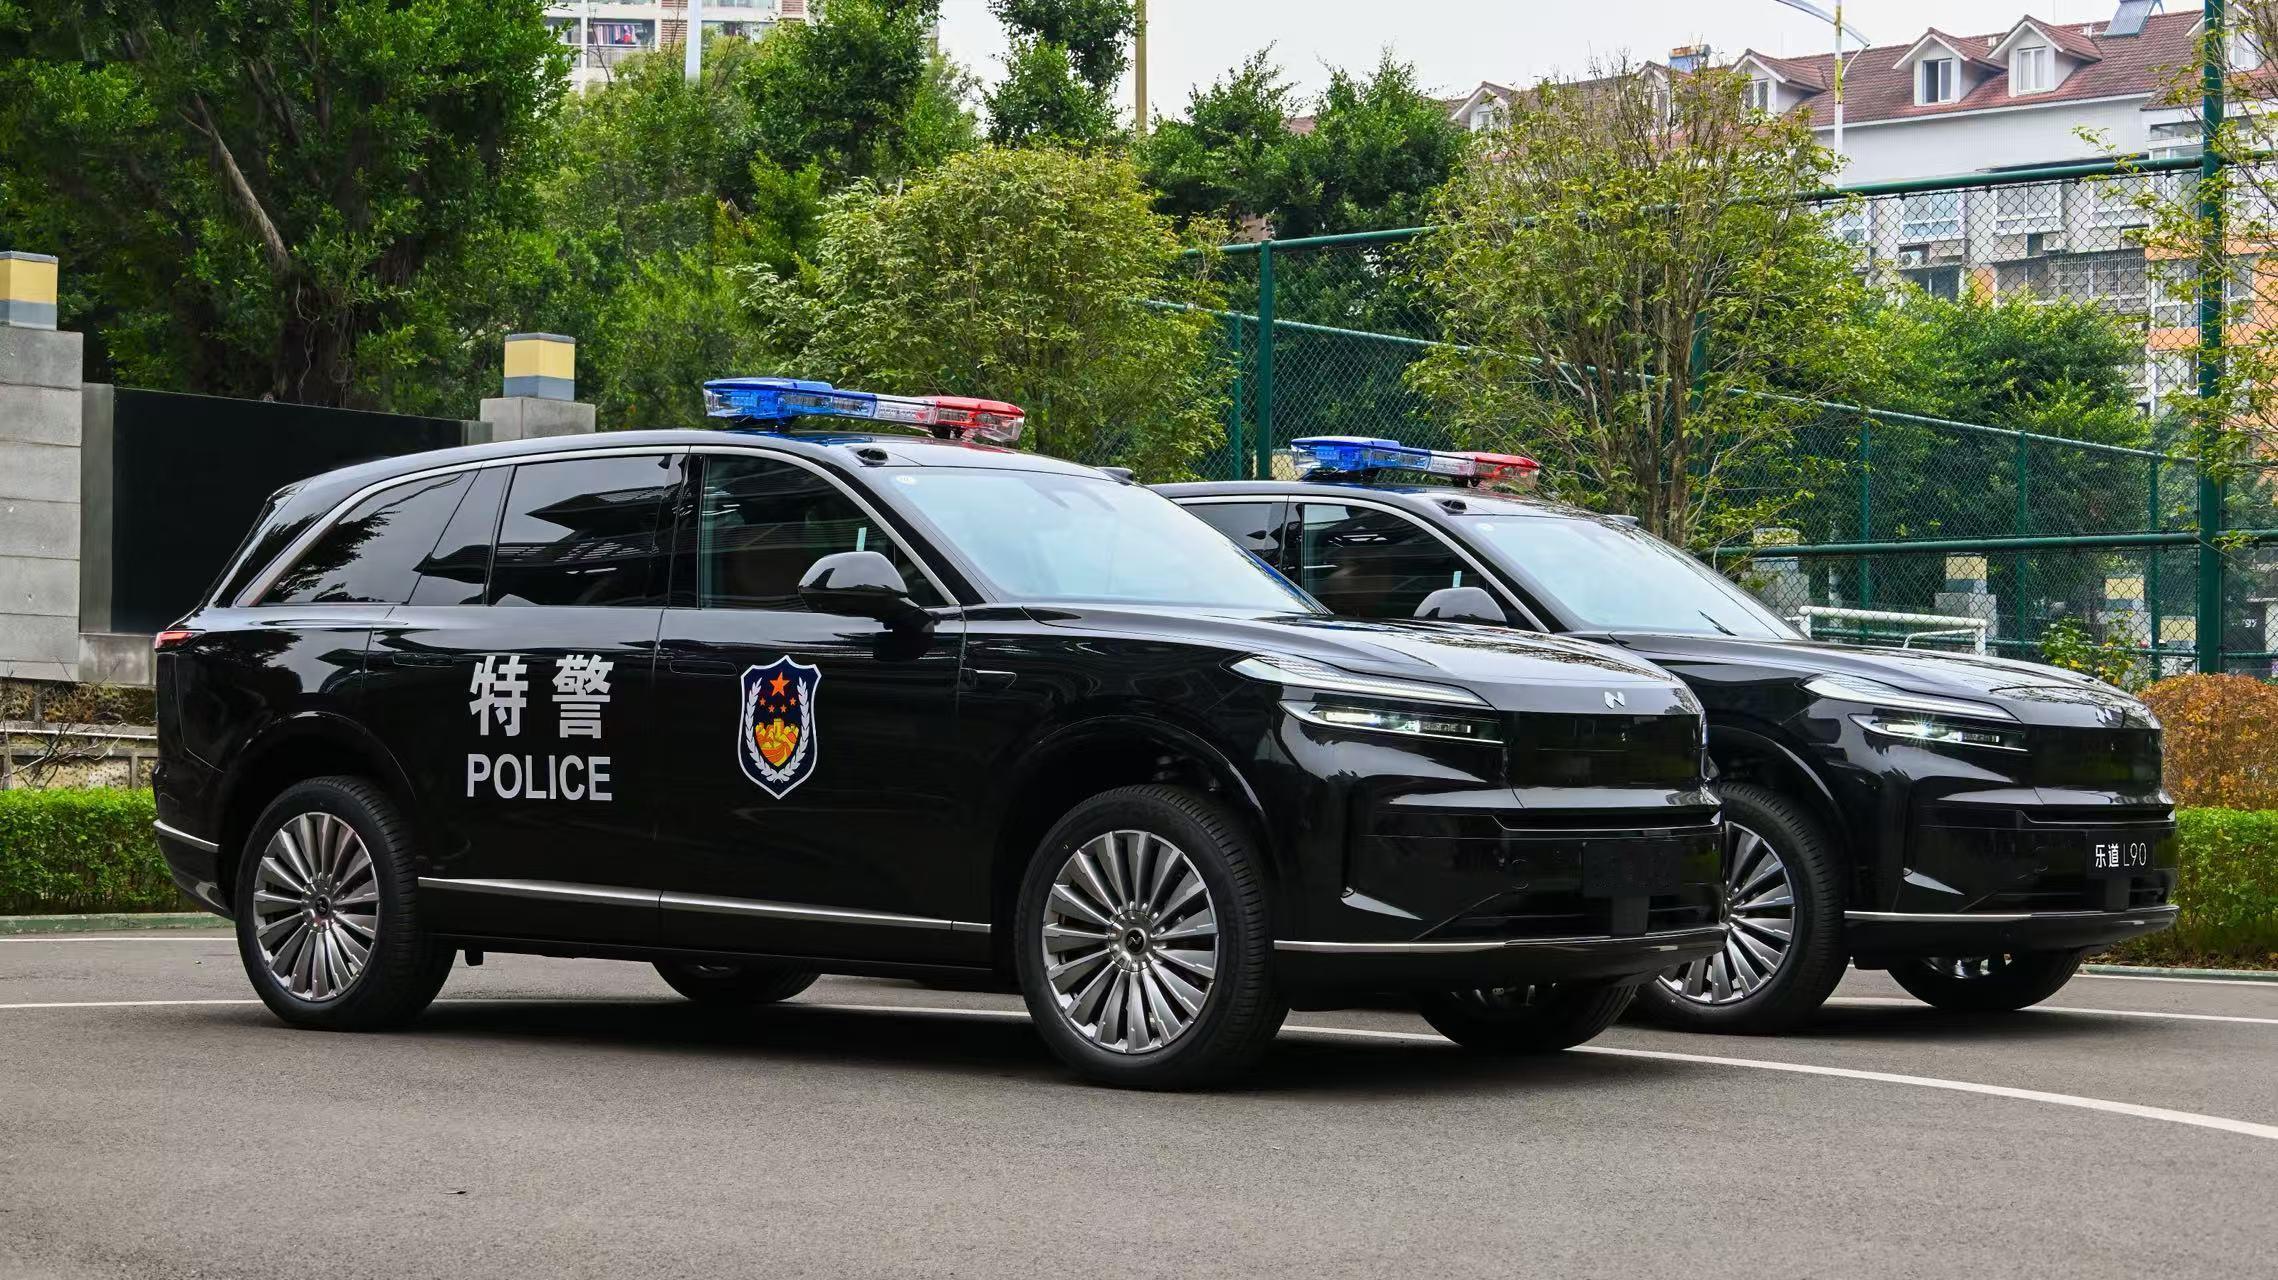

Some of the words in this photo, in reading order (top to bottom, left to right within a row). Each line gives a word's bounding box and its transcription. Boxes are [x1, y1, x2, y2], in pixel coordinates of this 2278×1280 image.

[469, 654, 614, 739] 特警
[466, 753, 613, 801] POLICE
[2095, 843, 2120, 868] 乐道
[2123, 842, 2147, 867] L90
